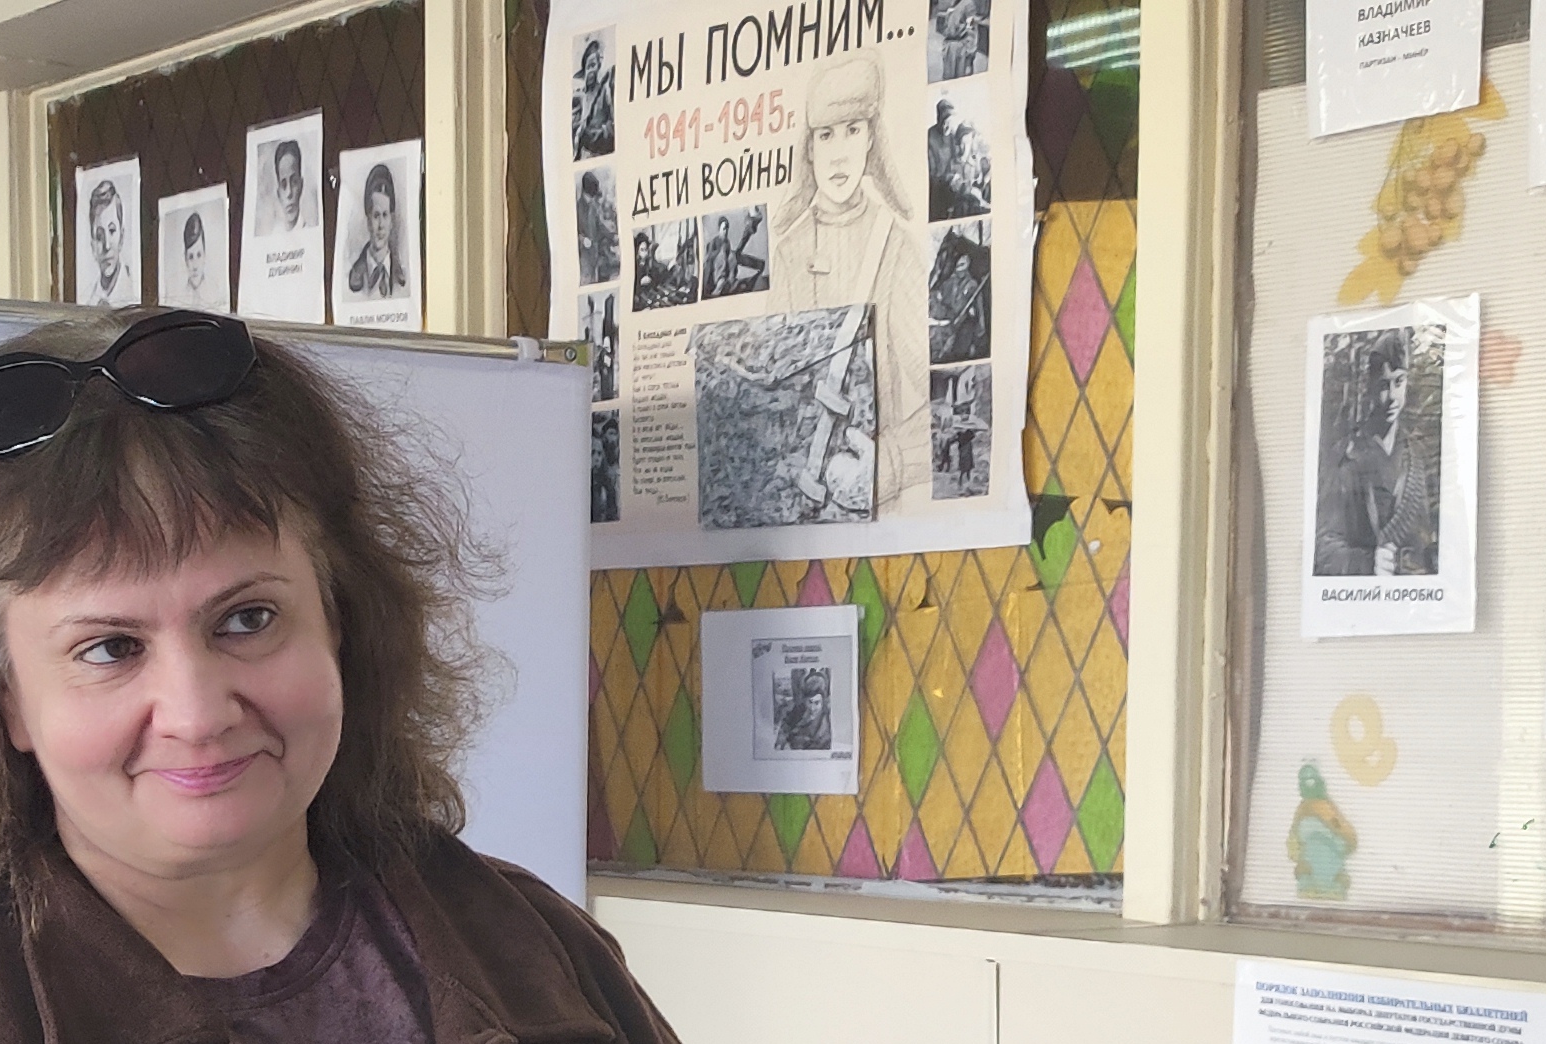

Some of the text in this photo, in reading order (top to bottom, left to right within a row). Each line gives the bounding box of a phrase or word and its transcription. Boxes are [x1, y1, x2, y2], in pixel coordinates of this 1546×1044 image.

[1358, 19, 1431, 48] КАЗНАЧЕЕВ
[629, 0, 915, 103] МЫ ПОМНИМ...
[632, 145, 794, 221] ДЕТИ ВОЙНЫ
[1321, 585, 1444, 602] ВАСИЛИЙ КОРОБКО
[1255, 981, 1298, 995] ПОРЯДОК
